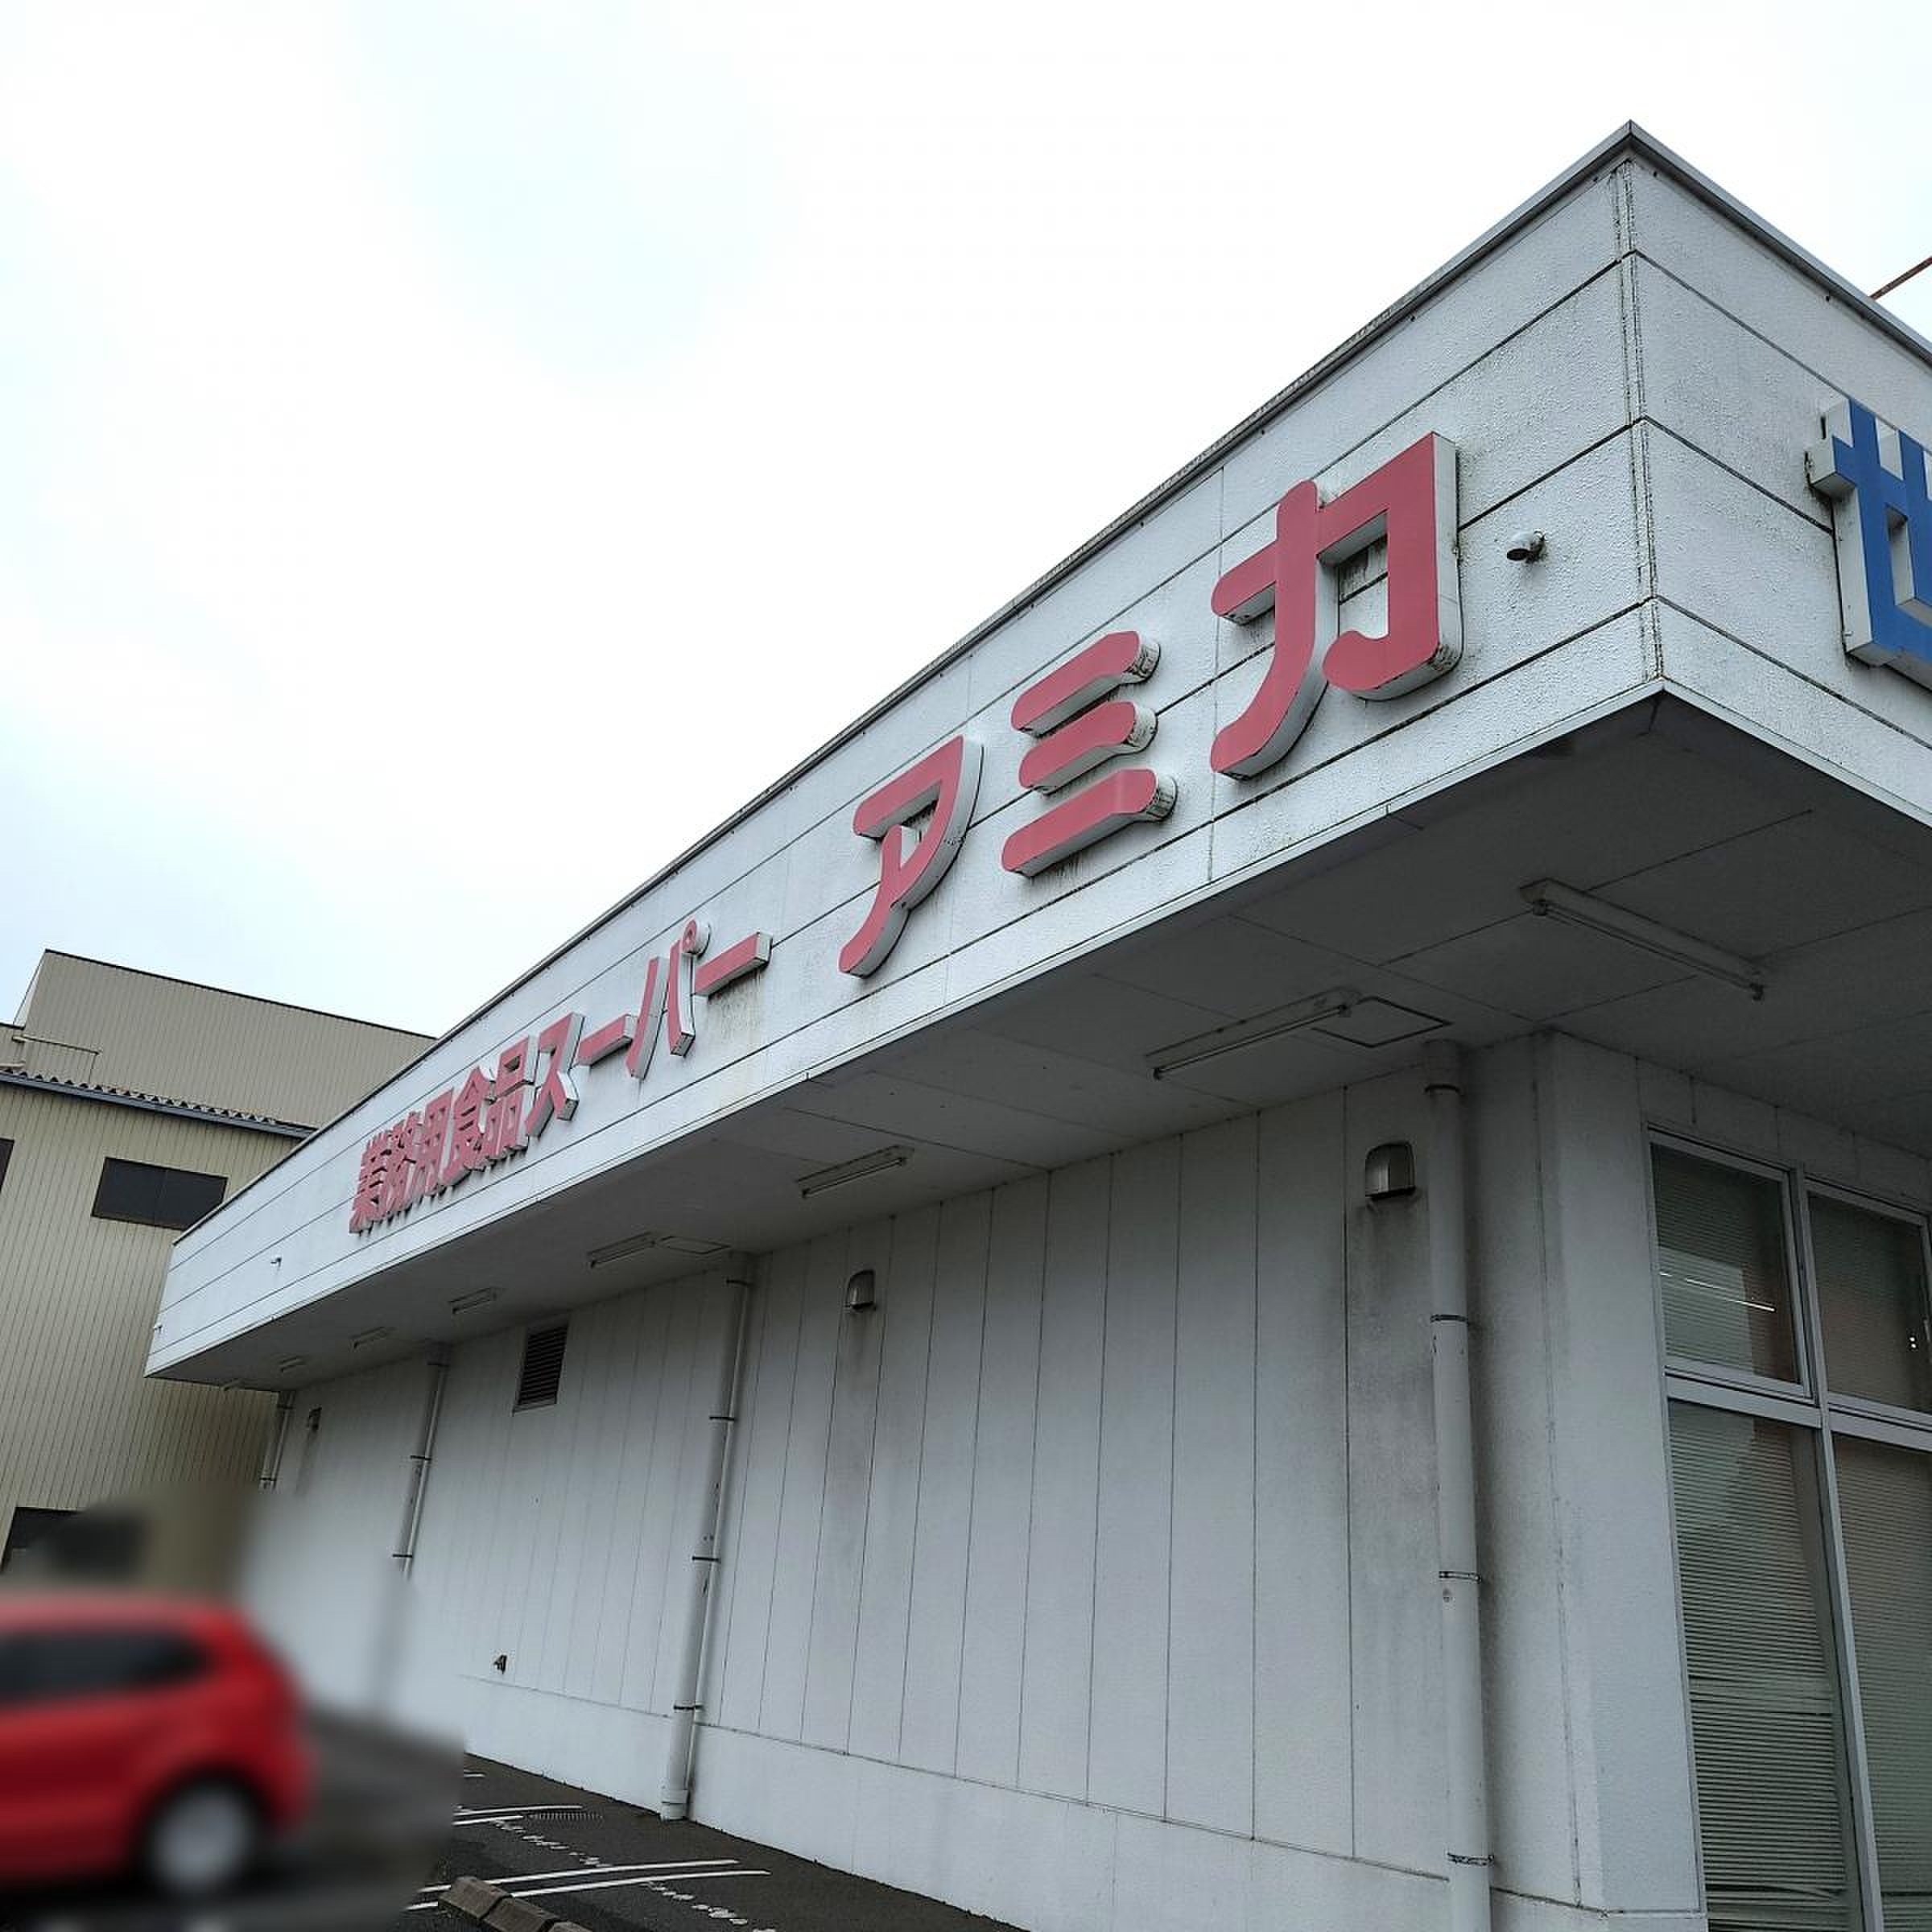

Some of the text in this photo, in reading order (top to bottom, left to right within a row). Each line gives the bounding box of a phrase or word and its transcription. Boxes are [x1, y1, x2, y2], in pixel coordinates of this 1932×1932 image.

[349, 431, 1459, 1233] 業務用食品スーパー アミカ
